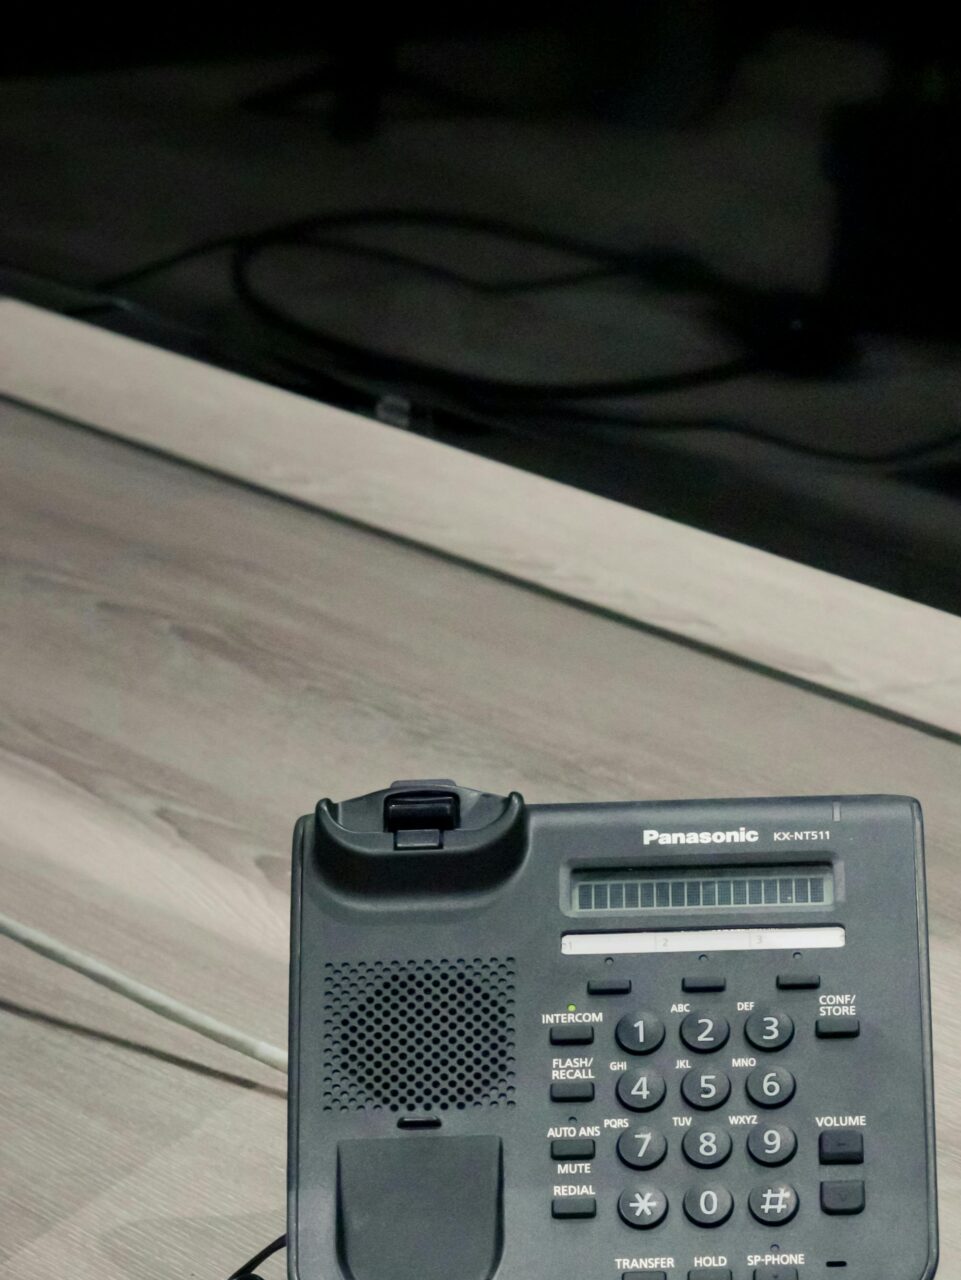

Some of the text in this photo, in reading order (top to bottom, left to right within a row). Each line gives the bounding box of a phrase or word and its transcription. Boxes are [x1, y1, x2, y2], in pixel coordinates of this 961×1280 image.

[643, 827, 759, 845] Panasonic
[773, 830, 831, 841] KX-NT511
[819, 995, 856, 1005] CONF/
[670, 1003, 691, 1013] ABC
[736, 1002, 755, 1011] DEF
[819, 1006, 856, 1016] STORE
[541, 1012, 603, 1024] INTERCOM
[633, 1020, 645, 1043] 1
[697, 1018, 714, 1042] 2
[762, 1017, 779, 1040] 3
[552, 1057, 594, 1069] FLASH/
[609, 1061, 627, 1071] GHI
[675, 1059, 692, 1069] JKL
[732, 1057, 757, 1067] MNO
[551, 1069, 595, 1080] RECALL
[630, 1076, 650, 1099] 4
[700, 1075, 716, 1098] 5
[762, 1072, 781, 1096] 6
[603, 1118, 630, 1128] PQRS
[672, 1116, 693, 1127] TUV
[728, 1114, 759, 1125] WXYZ
[815, 1115, 867, 1127] VOLUME
[547, 1126, 601, 1138] AUTO ANS
[634, 1132, 652, 1157] 7
[699, 1132, 717, 1156] 8
[763, 1129, 781, 1154] 9
[557, 1163, 591, 1174] MUTE
[553, 1185, 596, 1196] REDIAL
[699, 1190, 718, 1215] 0
[760, 1188, 790, 1214] #
[615, 1257, 675, 1269] TRANSFER
[694, 1256, 728, 1267] HOLD
[747, 1253, 805, 1266] SP-PHONE
